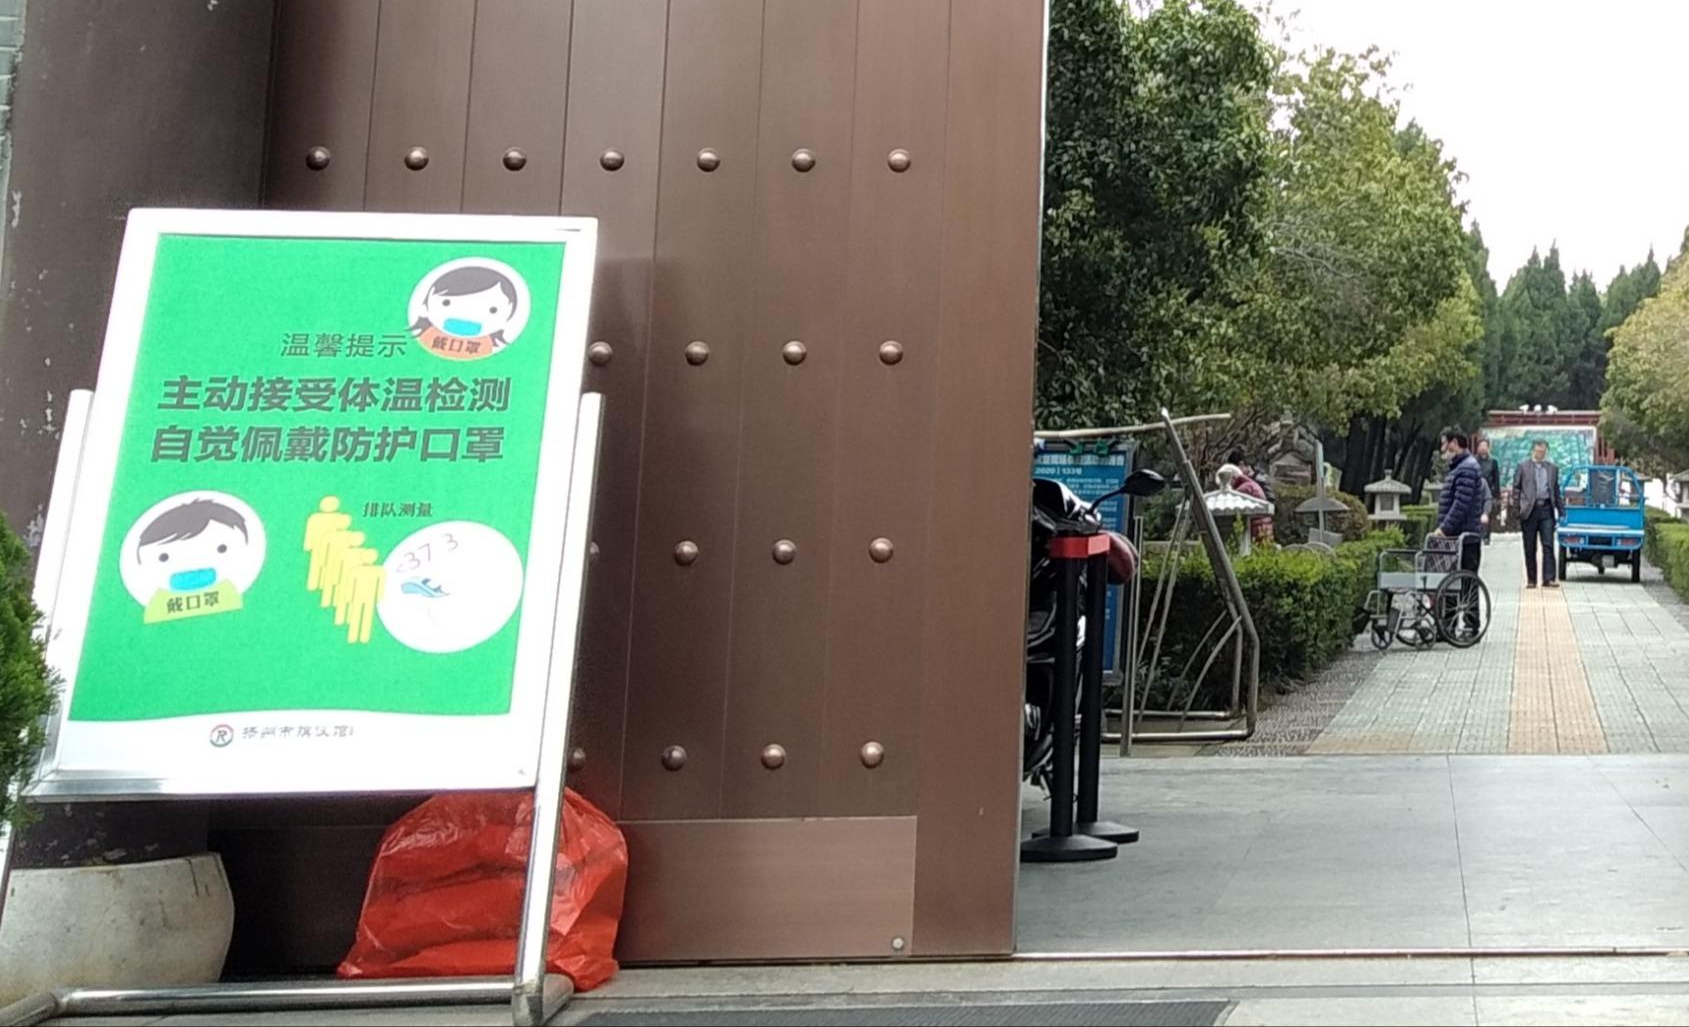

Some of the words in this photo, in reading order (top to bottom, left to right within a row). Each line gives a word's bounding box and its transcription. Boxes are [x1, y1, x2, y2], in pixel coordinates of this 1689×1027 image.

[280, 333, 407, 358] 温馨提示
[431, 335, 482, 354] 戴口罩
[157, 375, 512, 413] 主动接受体温检测
[151, 424, 506, 463] 自觉佩戴防护口罩
[362, 502, 433, 518] 排队测量
[166, 591, 219, 614] 戴口罩
